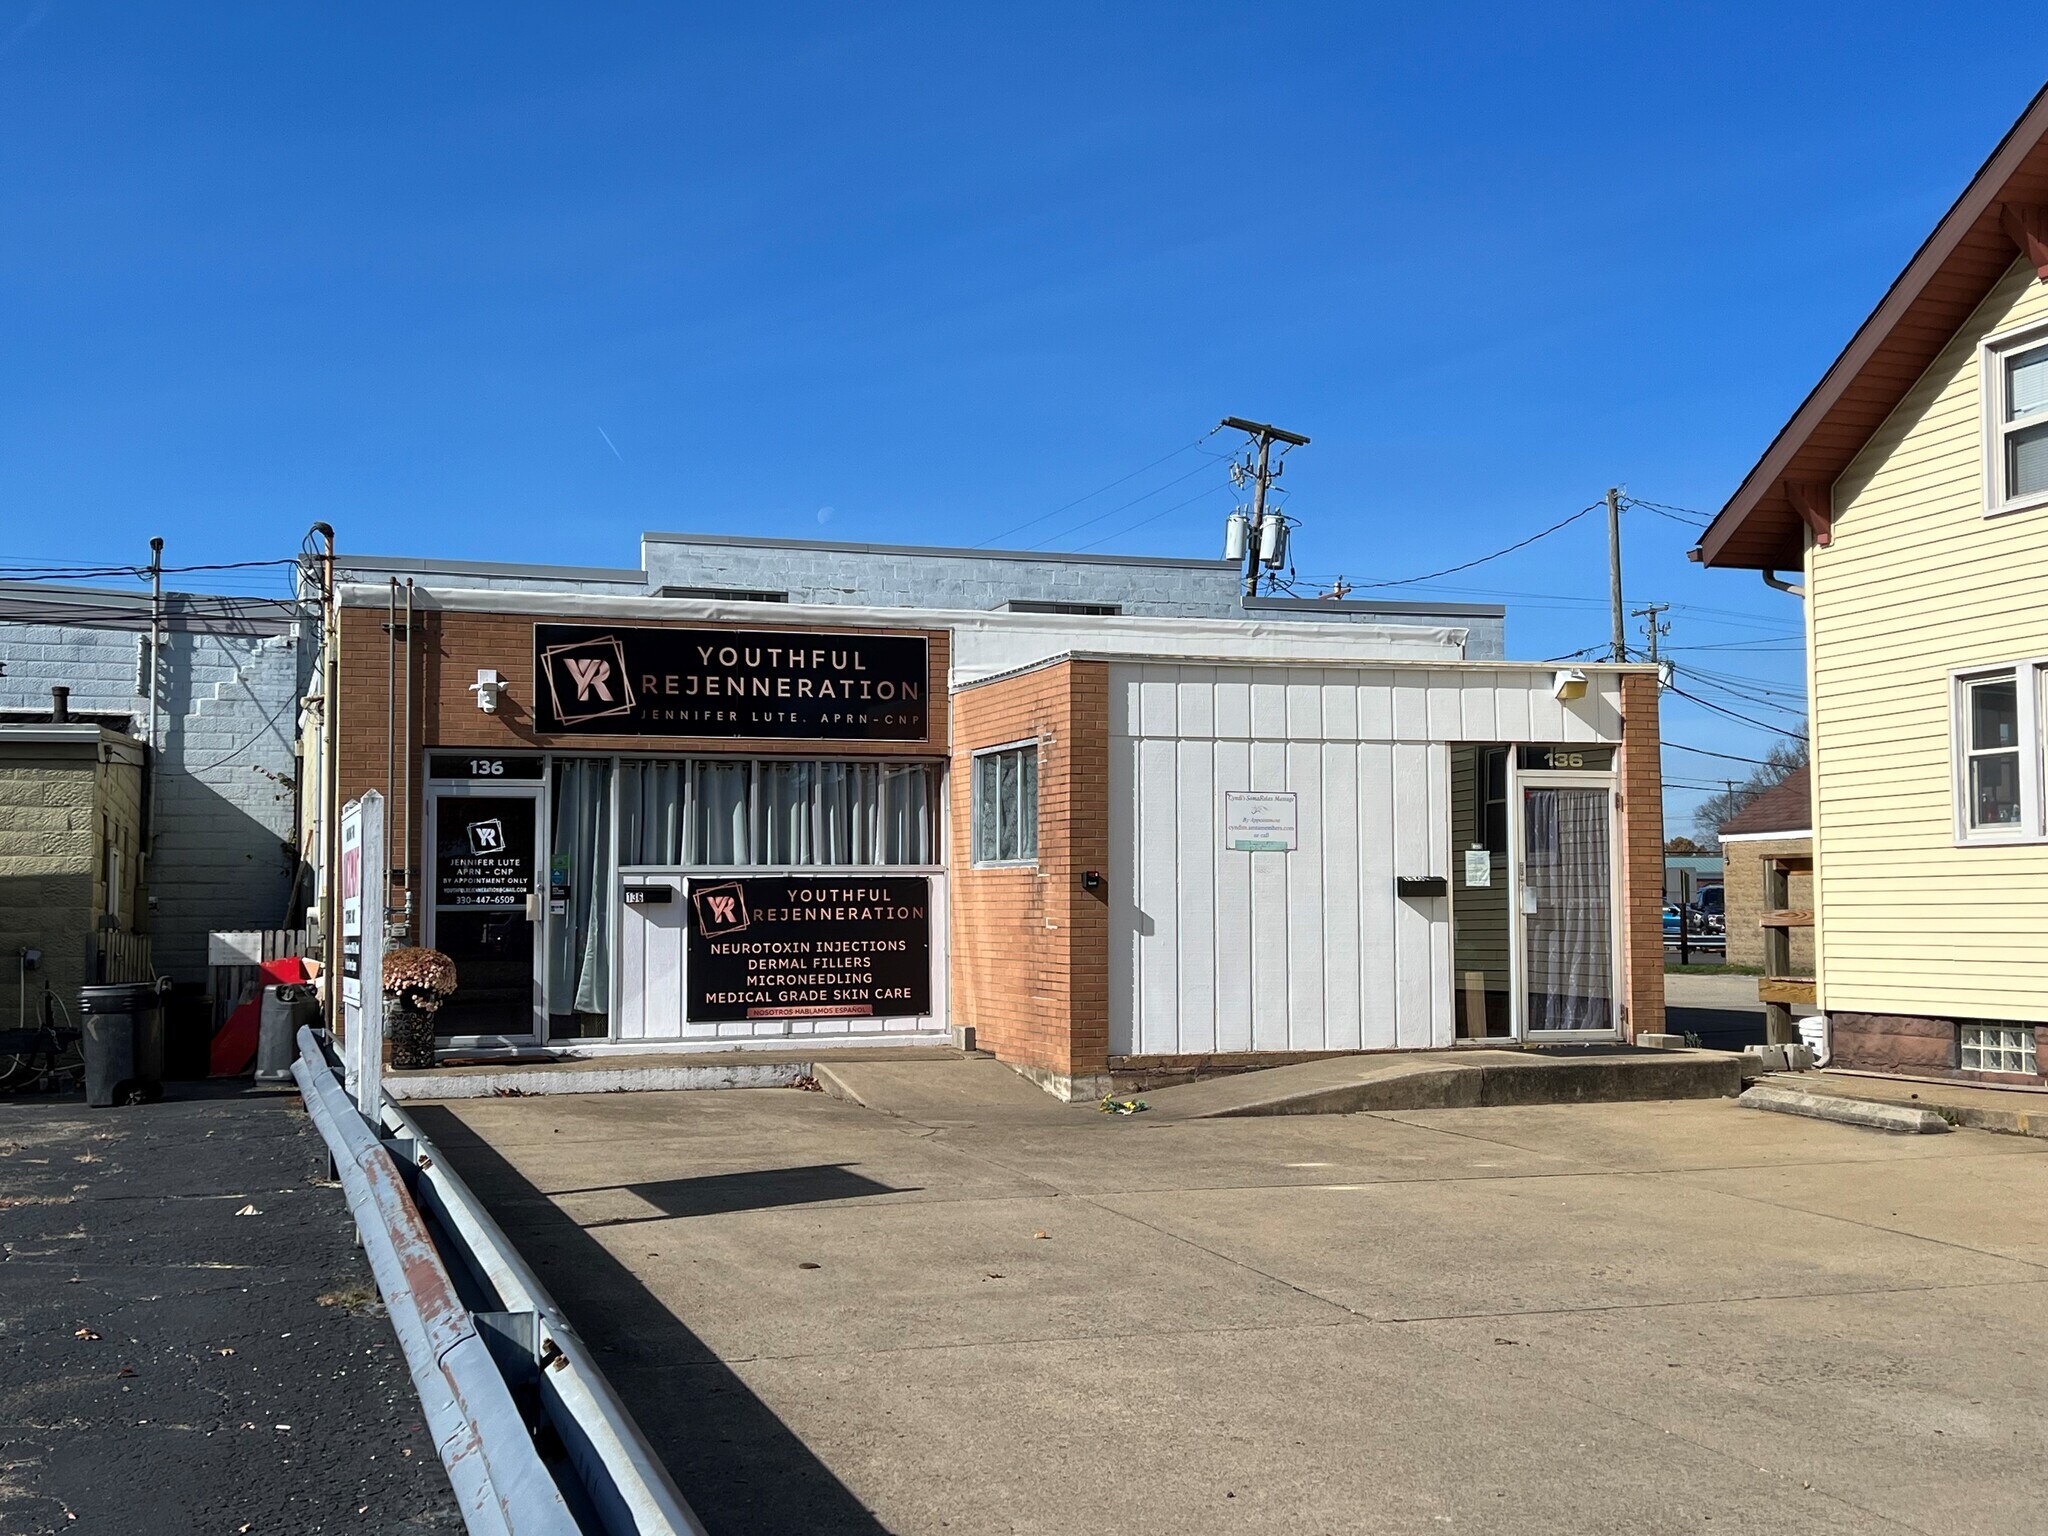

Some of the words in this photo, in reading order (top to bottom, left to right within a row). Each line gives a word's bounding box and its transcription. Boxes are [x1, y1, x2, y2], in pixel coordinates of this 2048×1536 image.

[697, 646, 866, 671] YOUTHFUL
[563, 658, 614, 702] YR
[642, 675, 919, 701] REJENNERATION
[641, 710, 737, 722] JENNIFER
[821, 713, 919, 725] APRN-CNP
[1543, 753, 1583, 767] 136
[470, 760, 504, 775] 136
[475, 827, 498, 847] YR
[456, 868, 481, 876] APRN
[493, 868, 514, 876] CNP
[456, 896, 515, 905] 330-447-6509
[626, 892, 644, 903] 136
[787, 888, 891, 902] YOUTHFUL
[707, 896, 737, 923] YR
[753, 906, 924, 922] REJENNERATION
[710, 942, 810, 955] NEUROTOXIN
[816, 941, 906, 952] INJECTIONS
[748, 959, 807, 970] DERMAL
[813, 957, 871, 969] FILLERS
[747, 973, 872, 986] MICRONEEDLING
[706, 991, 772, 1004] MEDICAL
[778, 989, 828, 1001] GRADE
[833, 988, 869, 1000] SKIN
[875, 988, 911, 999] CARE
[753, 1008, 793, 1016] NOSOTROS
[794, 1007, 833, 1015] HABLAMOS
[834, 1006, 866, 1014] ESPAÑOL
